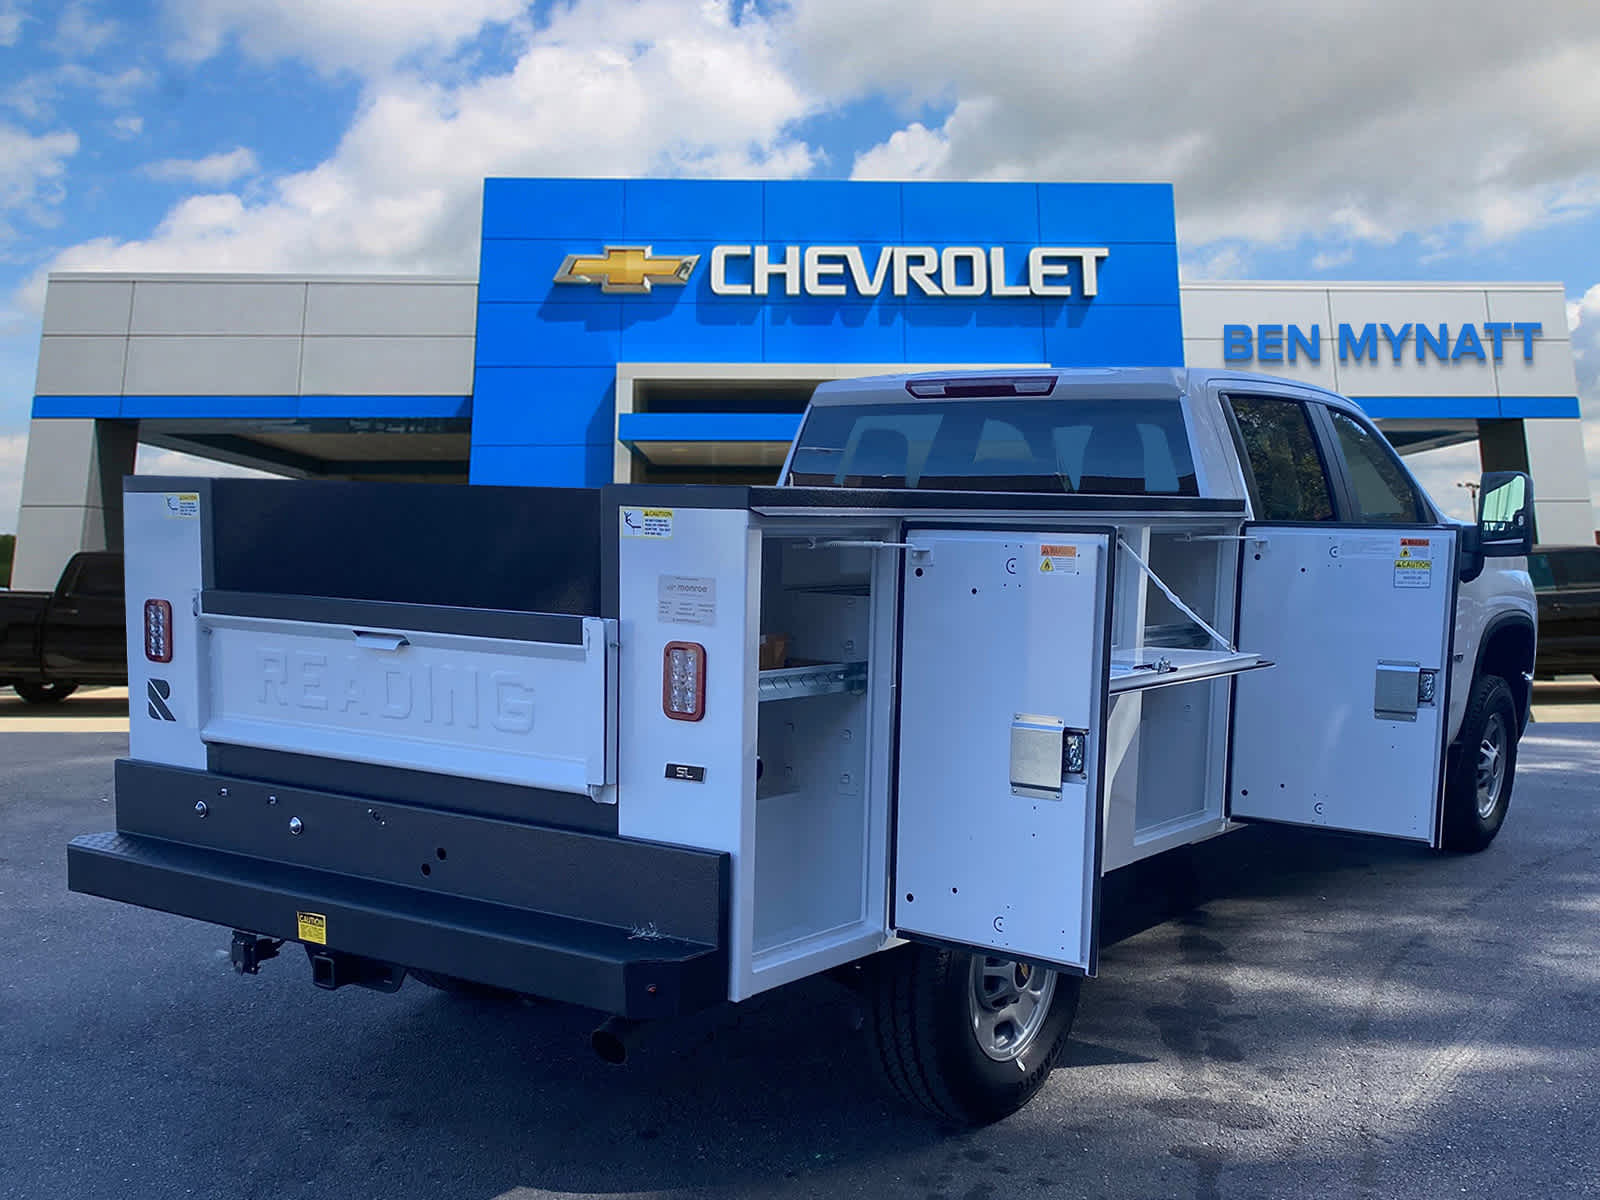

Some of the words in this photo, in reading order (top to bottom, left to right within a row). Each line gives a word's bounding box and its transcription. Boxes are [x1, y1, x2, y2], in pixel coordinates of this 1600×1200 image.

[710, 245, 1109, 296] CHEVROLET
[1223, 323, 1321, 362] BEN
[1338, 321, 1543, 361] MYNATT
[1401, 560, 1431, 569] CAUTION
[256, 647, 536, 736] READING
[299, 914, 325, 927] CAUTION
